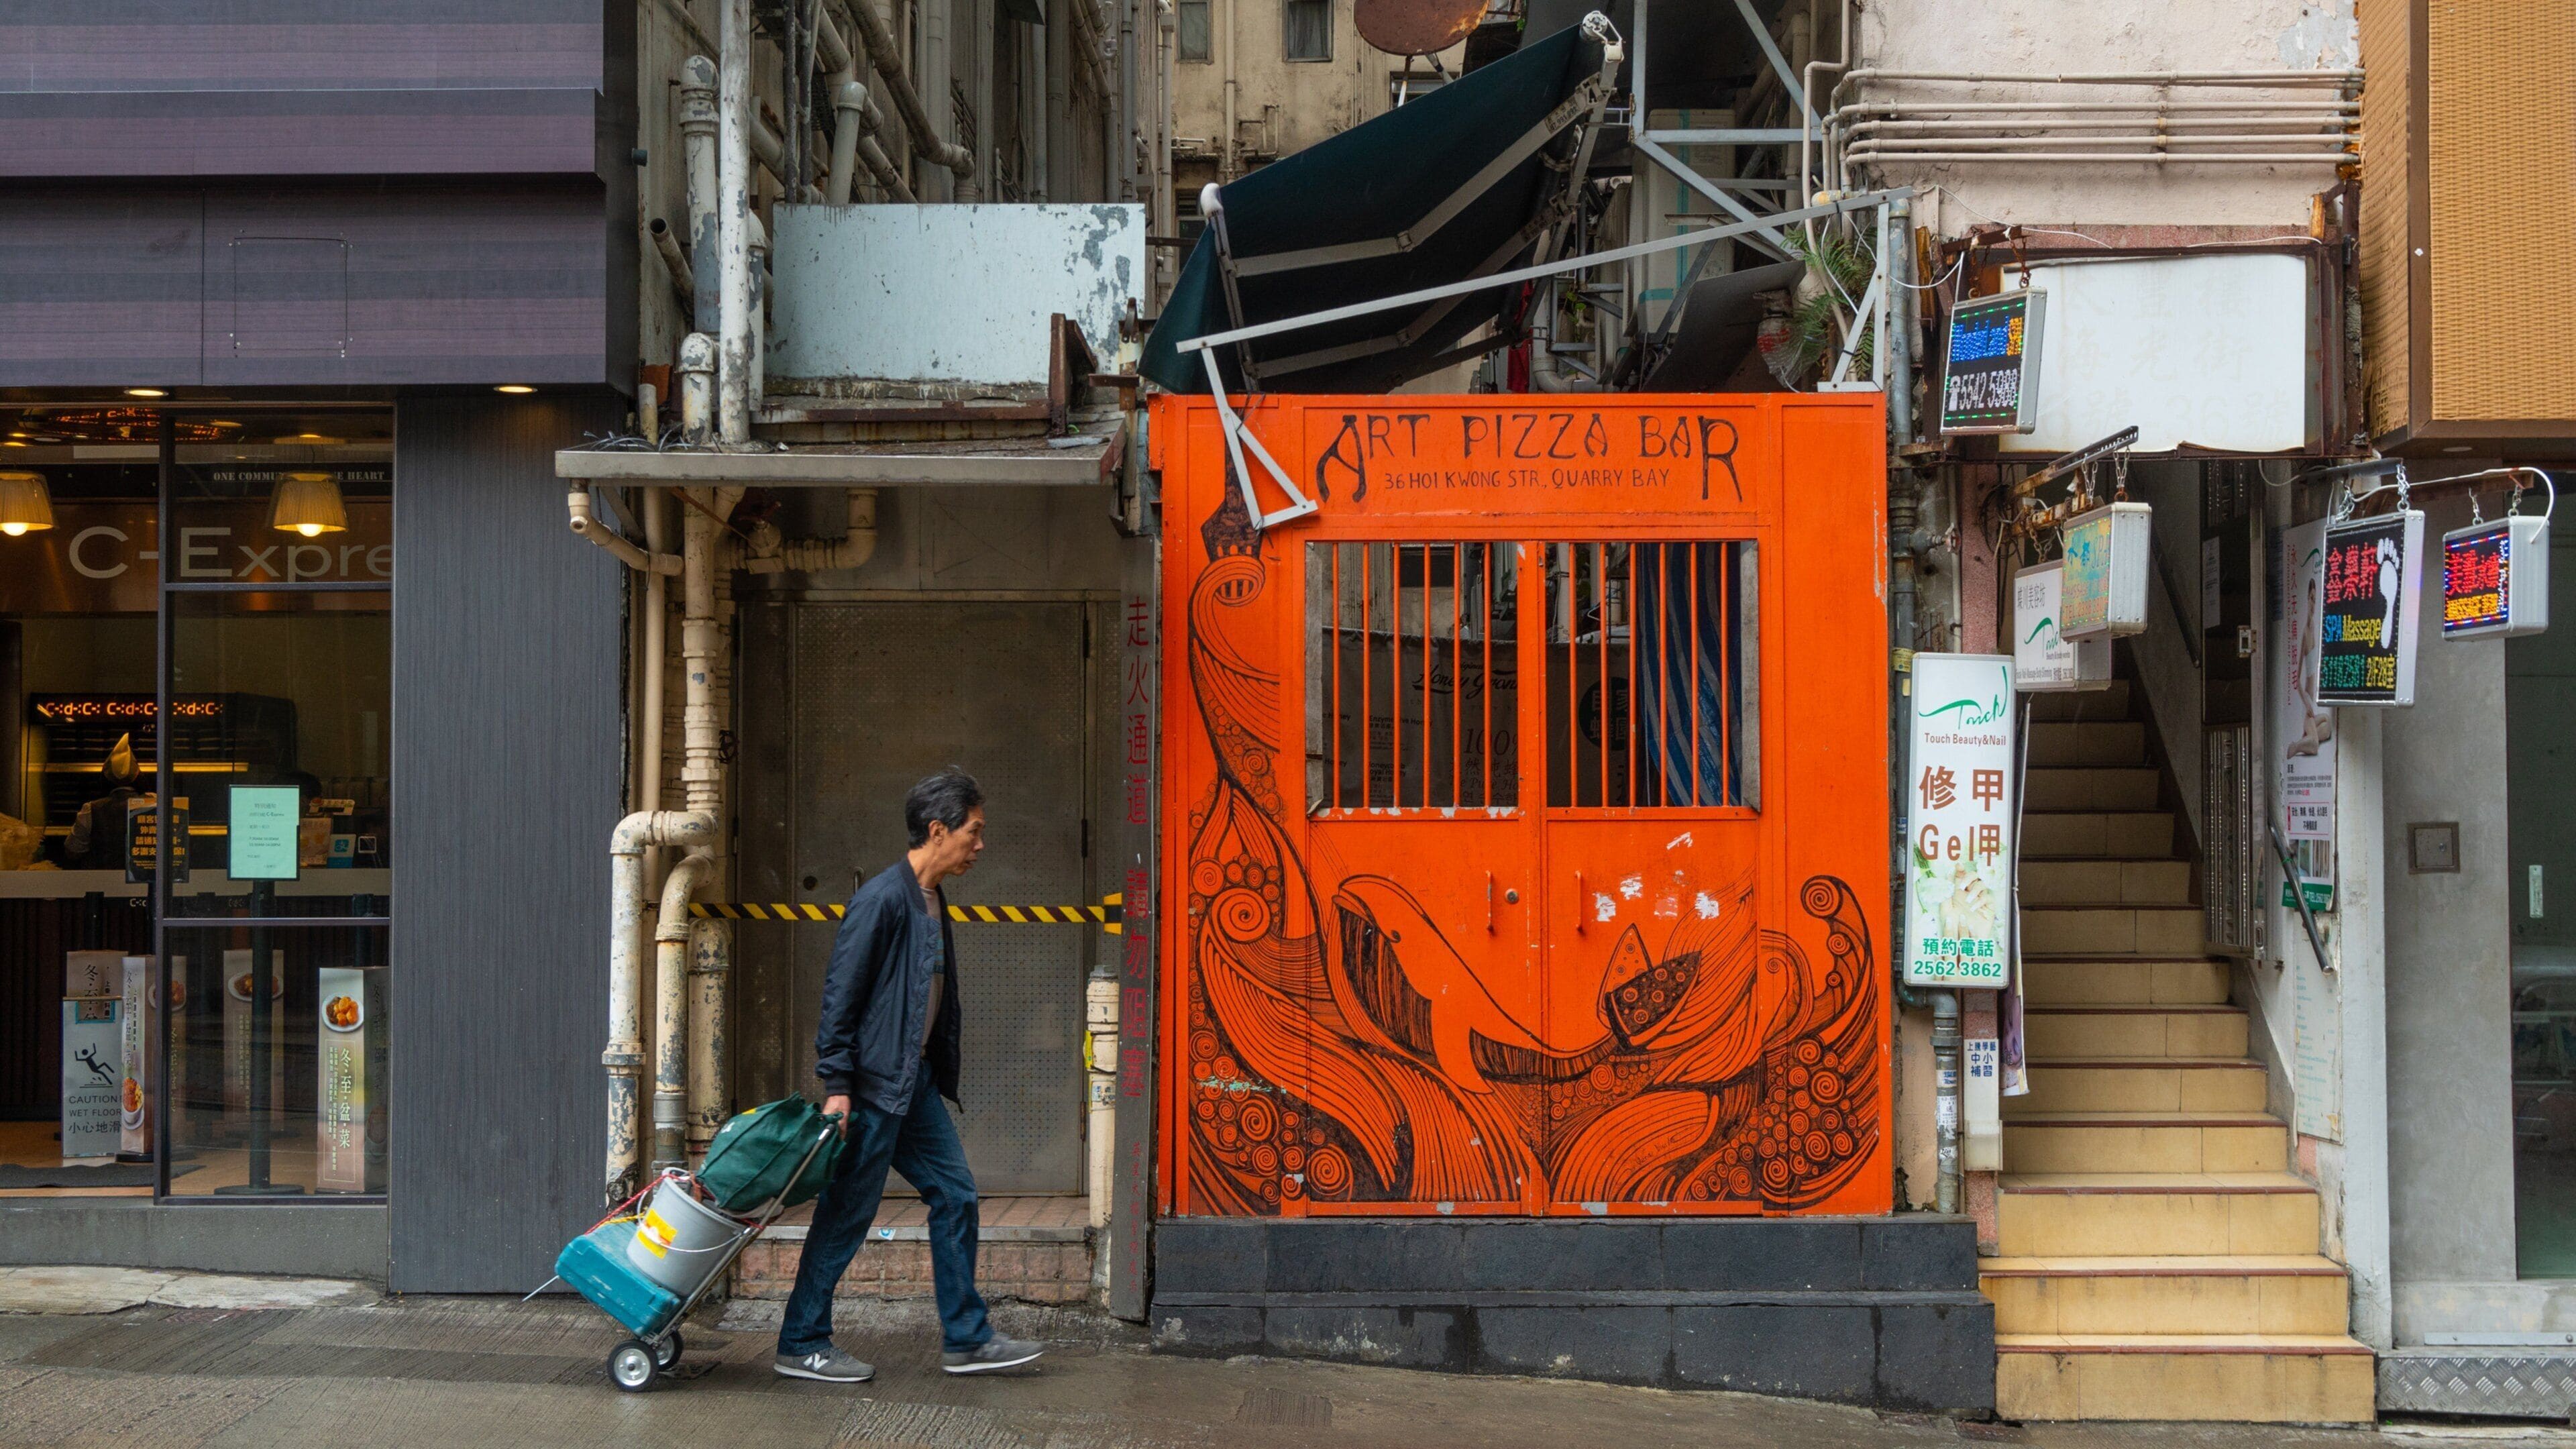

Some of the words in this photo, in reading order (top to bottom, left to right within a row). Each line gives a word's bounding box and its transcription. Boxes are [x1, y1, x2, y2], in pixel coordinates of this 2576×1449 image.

[1959, 371, 1987, 411] 5542
[1316, 414, 1430, 504] ART
[1461, 413, 1609, 460] PIZZA
[1638, 415, 1743, 502] BAR
[213, 472, 234, 480] ONE
[347, 471, 384, 480] HEART
[1384, 472, 1405, 490] 36
[1409, 472, 1438, 490] HOI
[1445, 470, 1501, 489] KWONG
[1552, 468, 1622, 490] QUARRY
[1632, 468, 1670, 488] BAY
[2324, 614, 2342, 642] SPA
[2343, 615, 2382, 648] Massage
[1919, 666, 2008, 730] Touch
[1127, 596, 1149, 824] 走火通道
[1925, 733, 1950, 744] Touch
[1953, 733, 2006, 747] Beauty&Nail
[1919, 765, 2004, 812] 修甲
[1919, 823, 2000, 867] Gel甲
[1923, 938, 1996, 957] 預約電話
[1914, 960, 1956, 975] 2562
[1960, 962, 2002, 977] 3862
[1122, 869, 1149, 1098] 請勿阻塞
[1971, 1052, 1994, 1065] 中小
[1970, 1065, 1993, 1077] 補習
[69, 1109, 88, 1117] WET
[92, 1108, 121, 1116] FLOOR
[68, 1121, 121, 1134] 小心地滑
